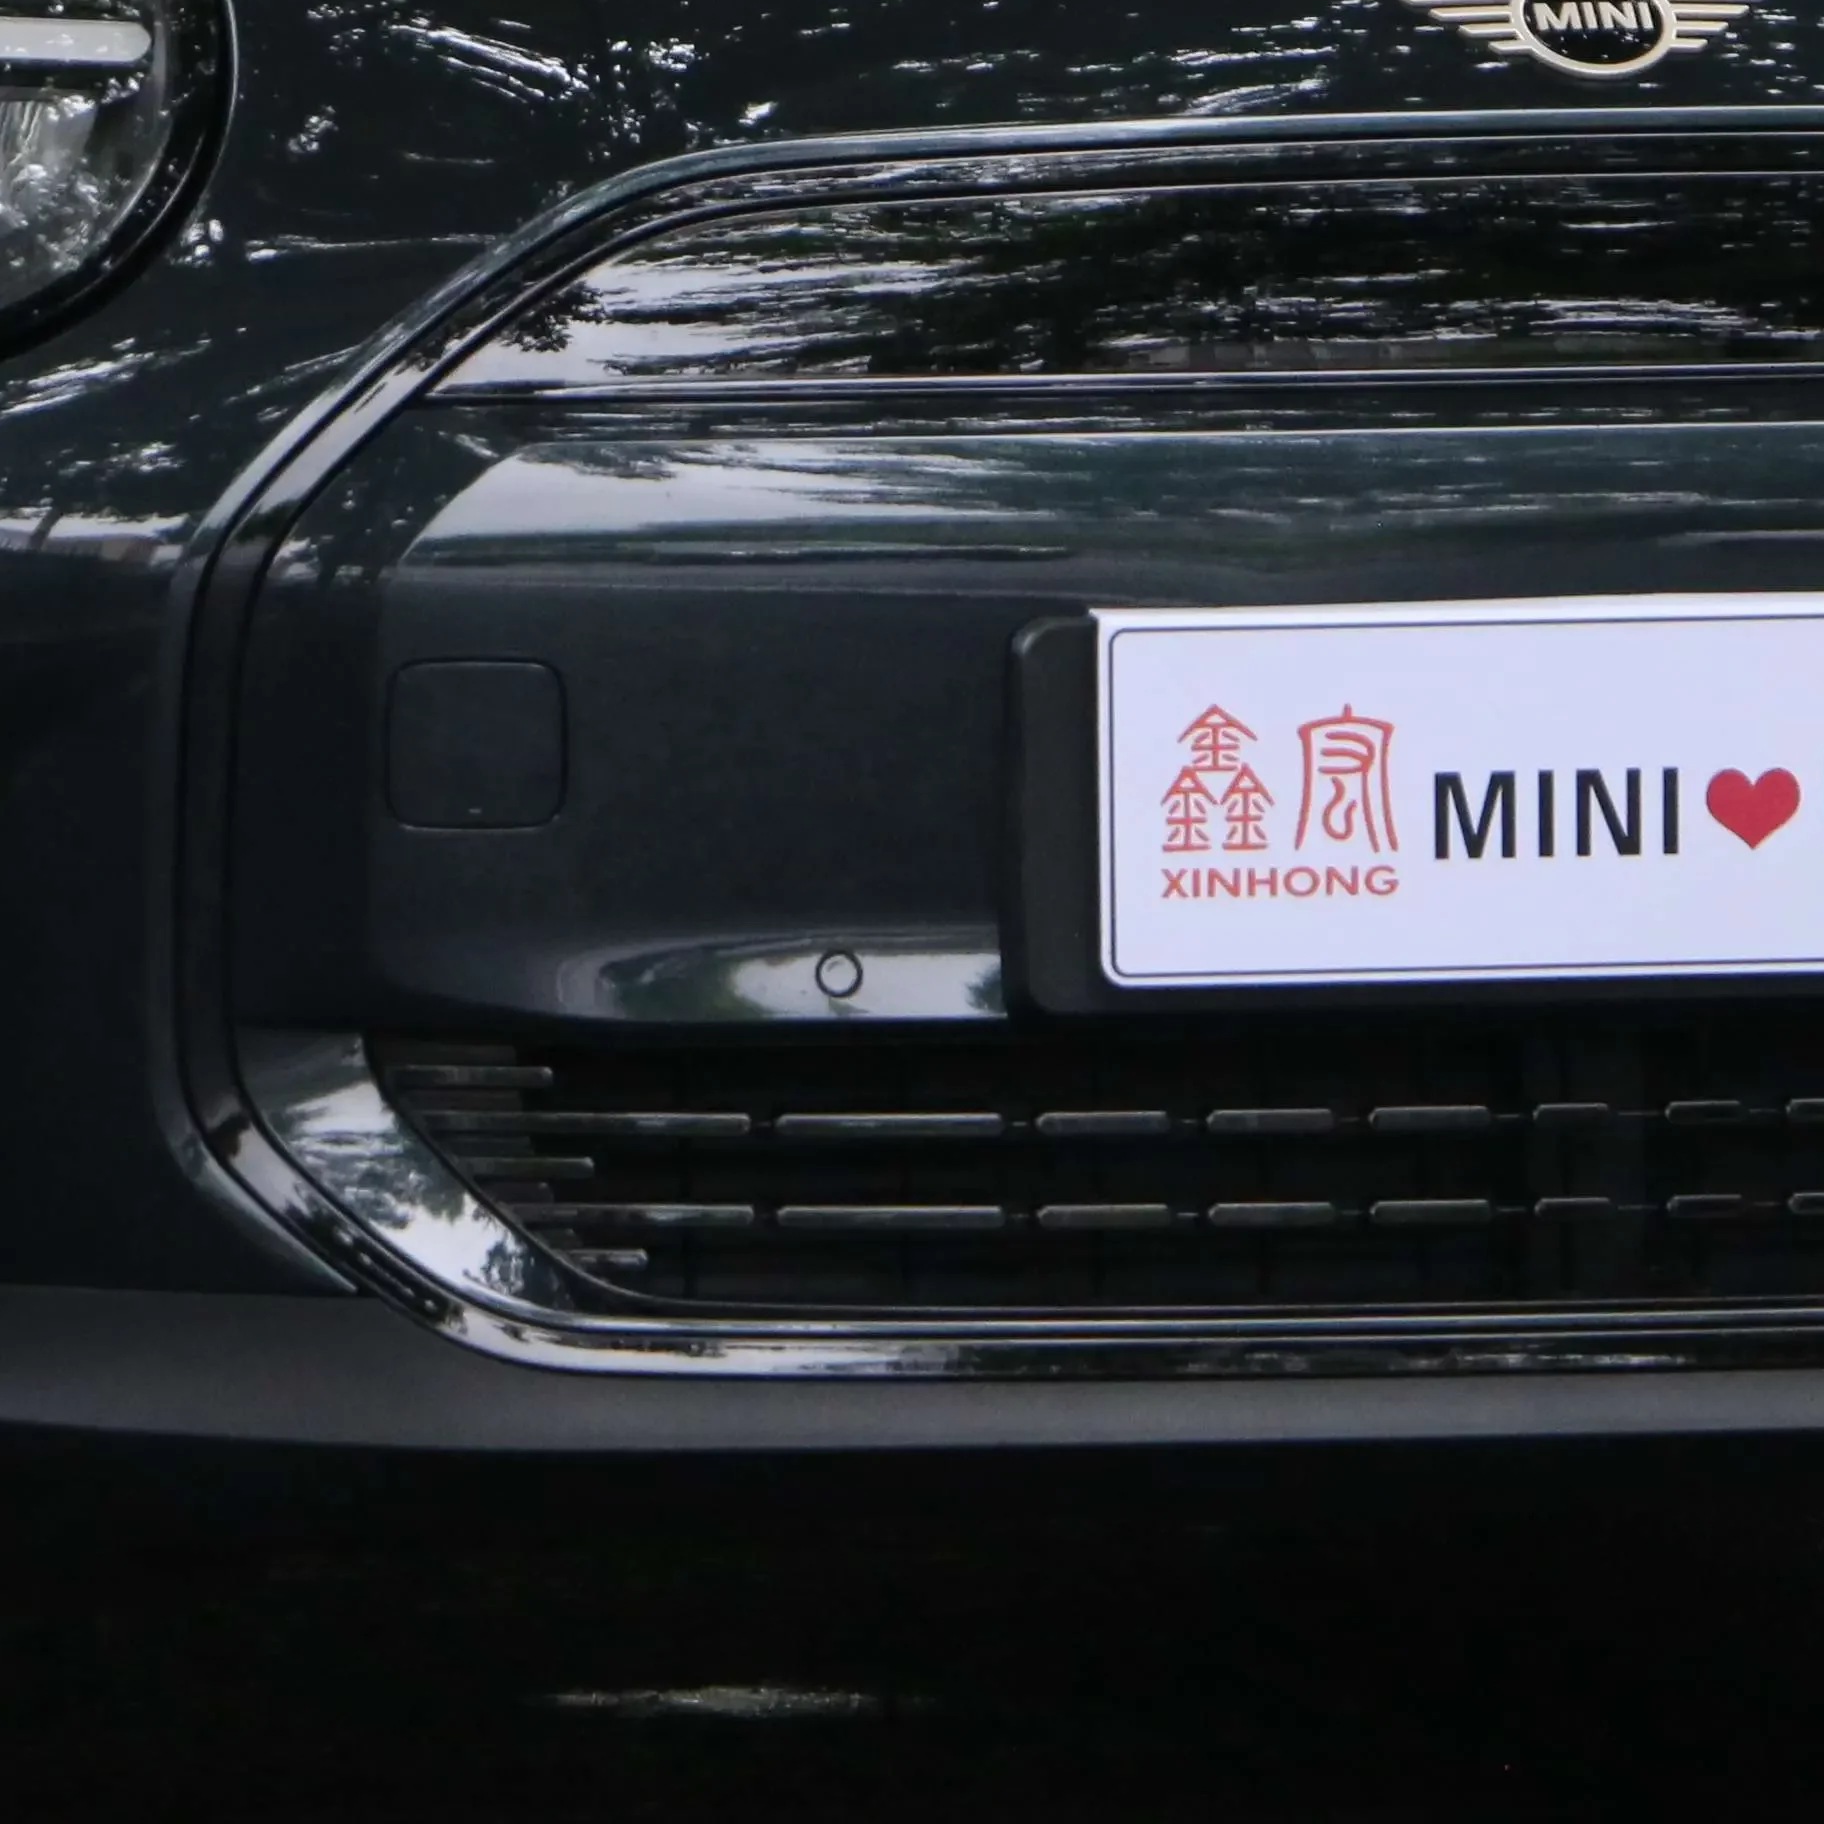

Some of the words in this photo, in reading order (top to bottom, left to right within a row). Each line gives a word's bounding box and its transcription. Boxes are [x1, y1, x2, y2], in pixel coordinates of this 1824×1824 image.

[1531, 0, 1655, 32] MINI
[1433, 767, 1679, 859] MINI
[1160, 865, 1399, 898] XINHONG
